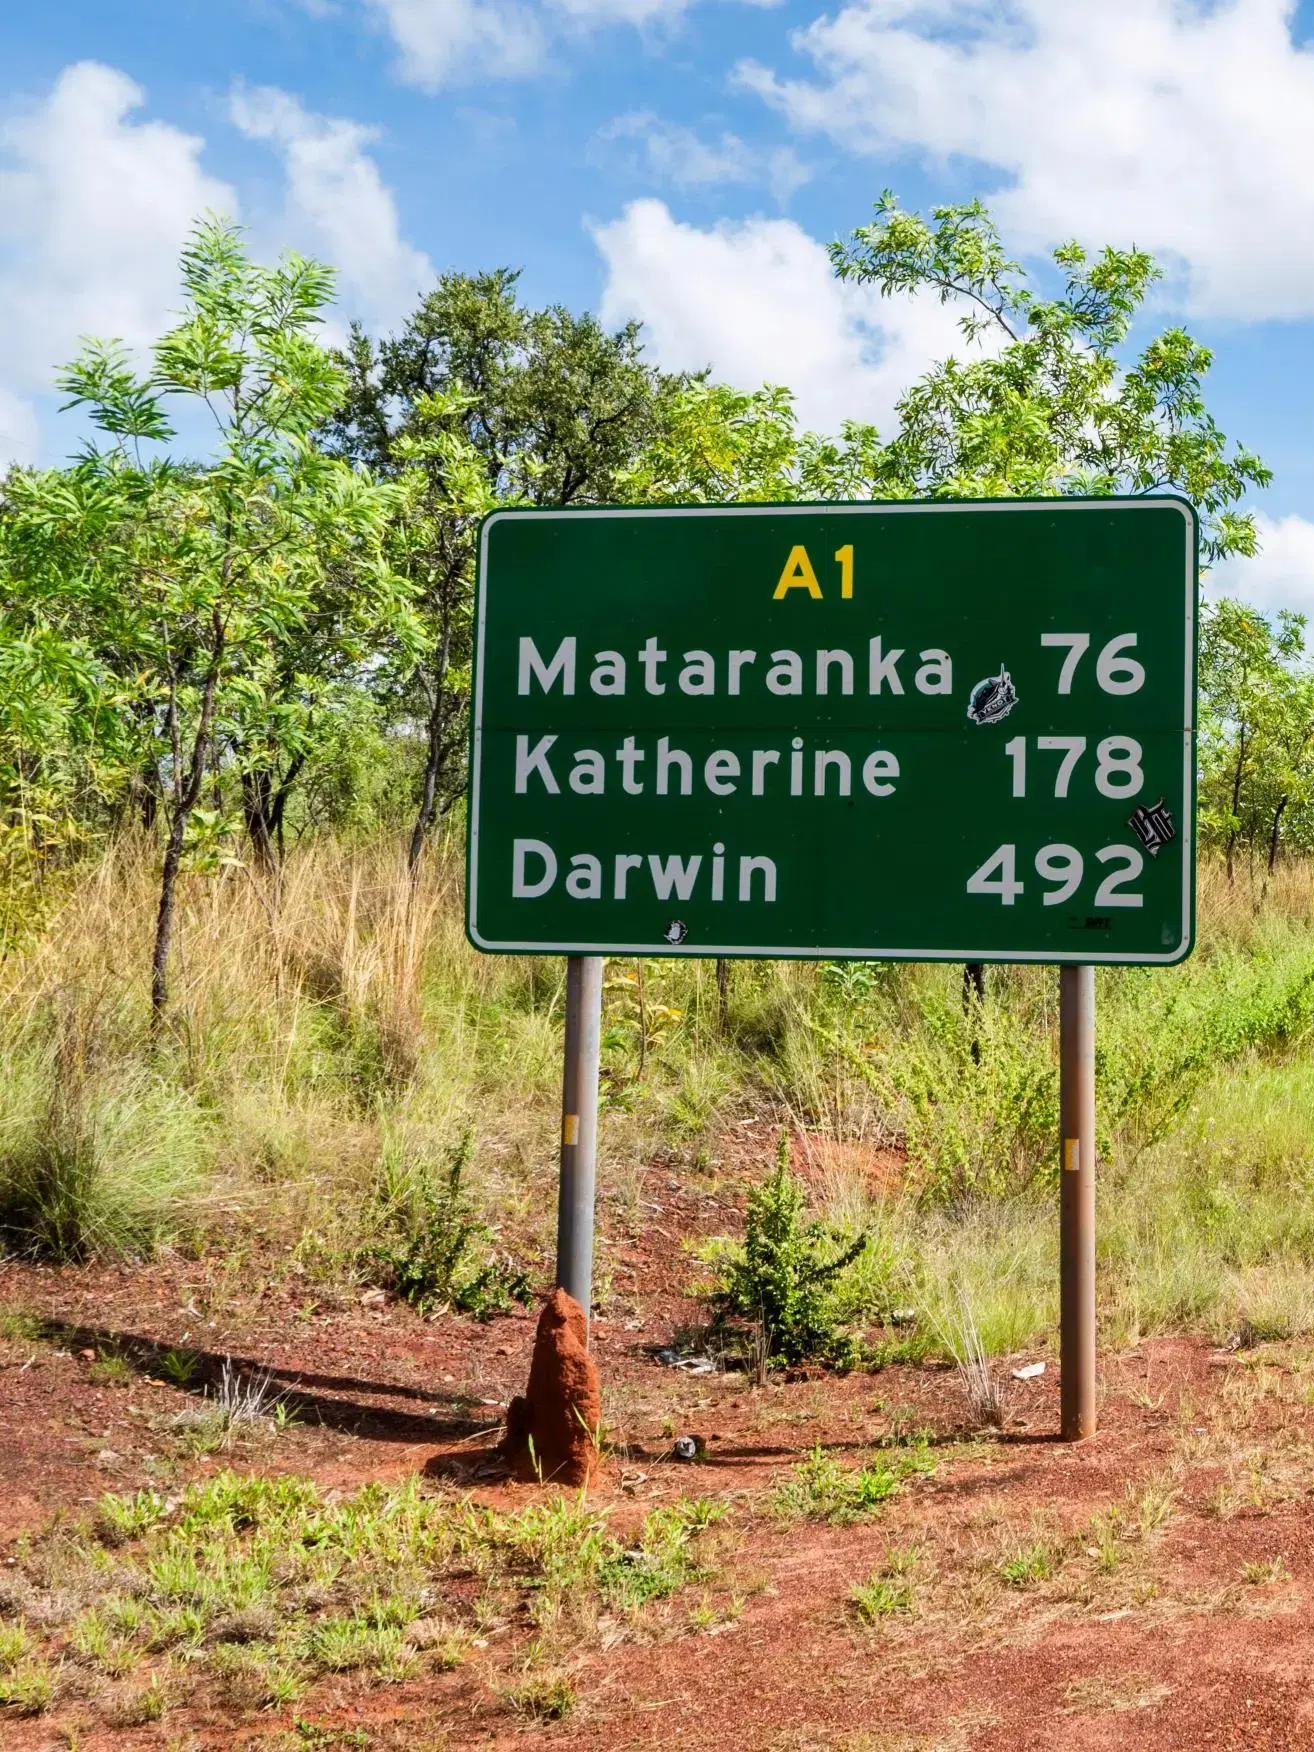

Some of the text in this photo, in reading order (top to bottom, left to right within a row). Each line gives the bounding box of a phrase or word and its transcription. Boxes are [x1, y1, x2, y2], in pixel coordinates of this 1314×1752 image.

[772, 544, 854, 600] A1
[518, 633, 1146, 696] Mataranka 76
[514, 735, 1145, 799] Katherine 178
[512, 839, 1144, 907] Darwin 492
